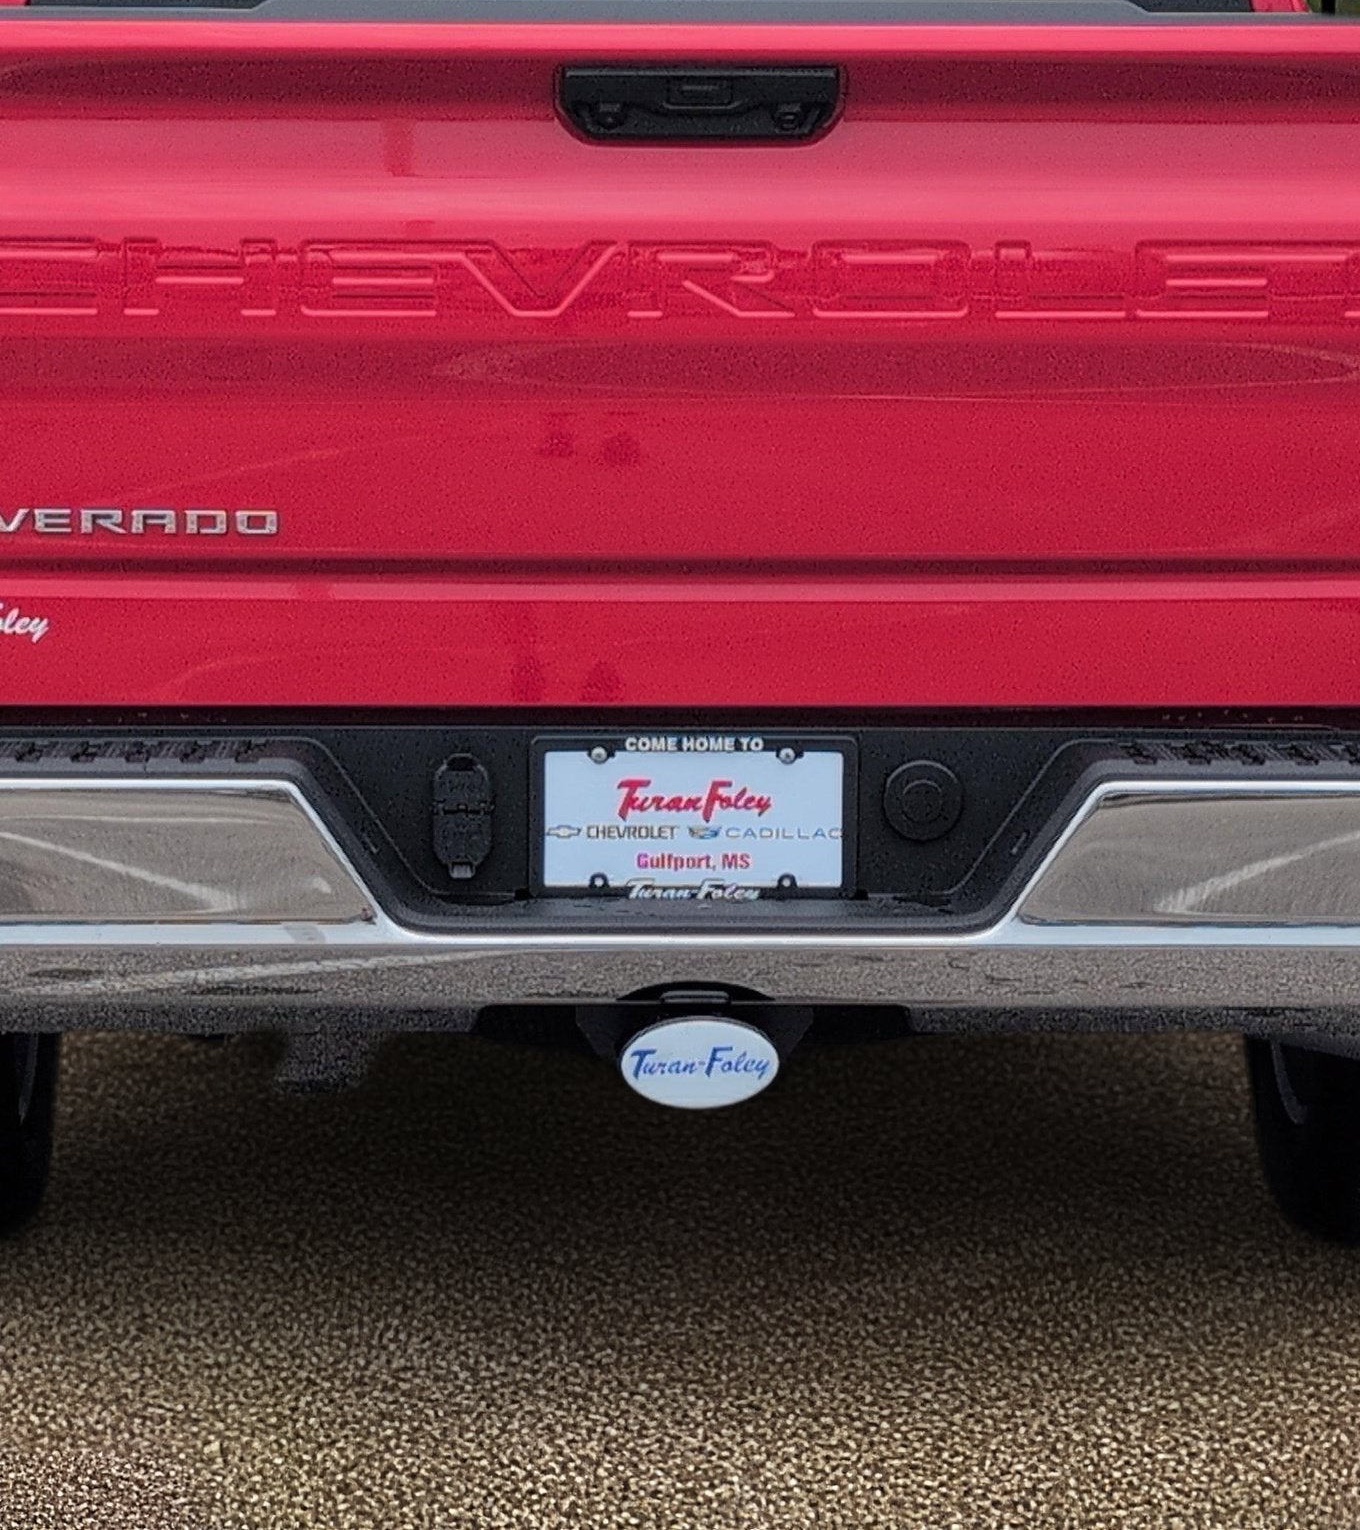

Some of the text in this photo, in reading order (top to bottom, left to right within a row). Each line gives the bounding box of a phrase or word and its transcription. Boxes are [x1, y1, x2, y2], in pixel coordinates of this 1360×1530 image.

[625, 736, 764, 752] COME HOME TO
[586, 825, 842, 840] CHEVROLET CADILLAC
[637, 852, 751, 871] Gulfport, MS
[630, 1046, 770, 1080] Turan-Foley
